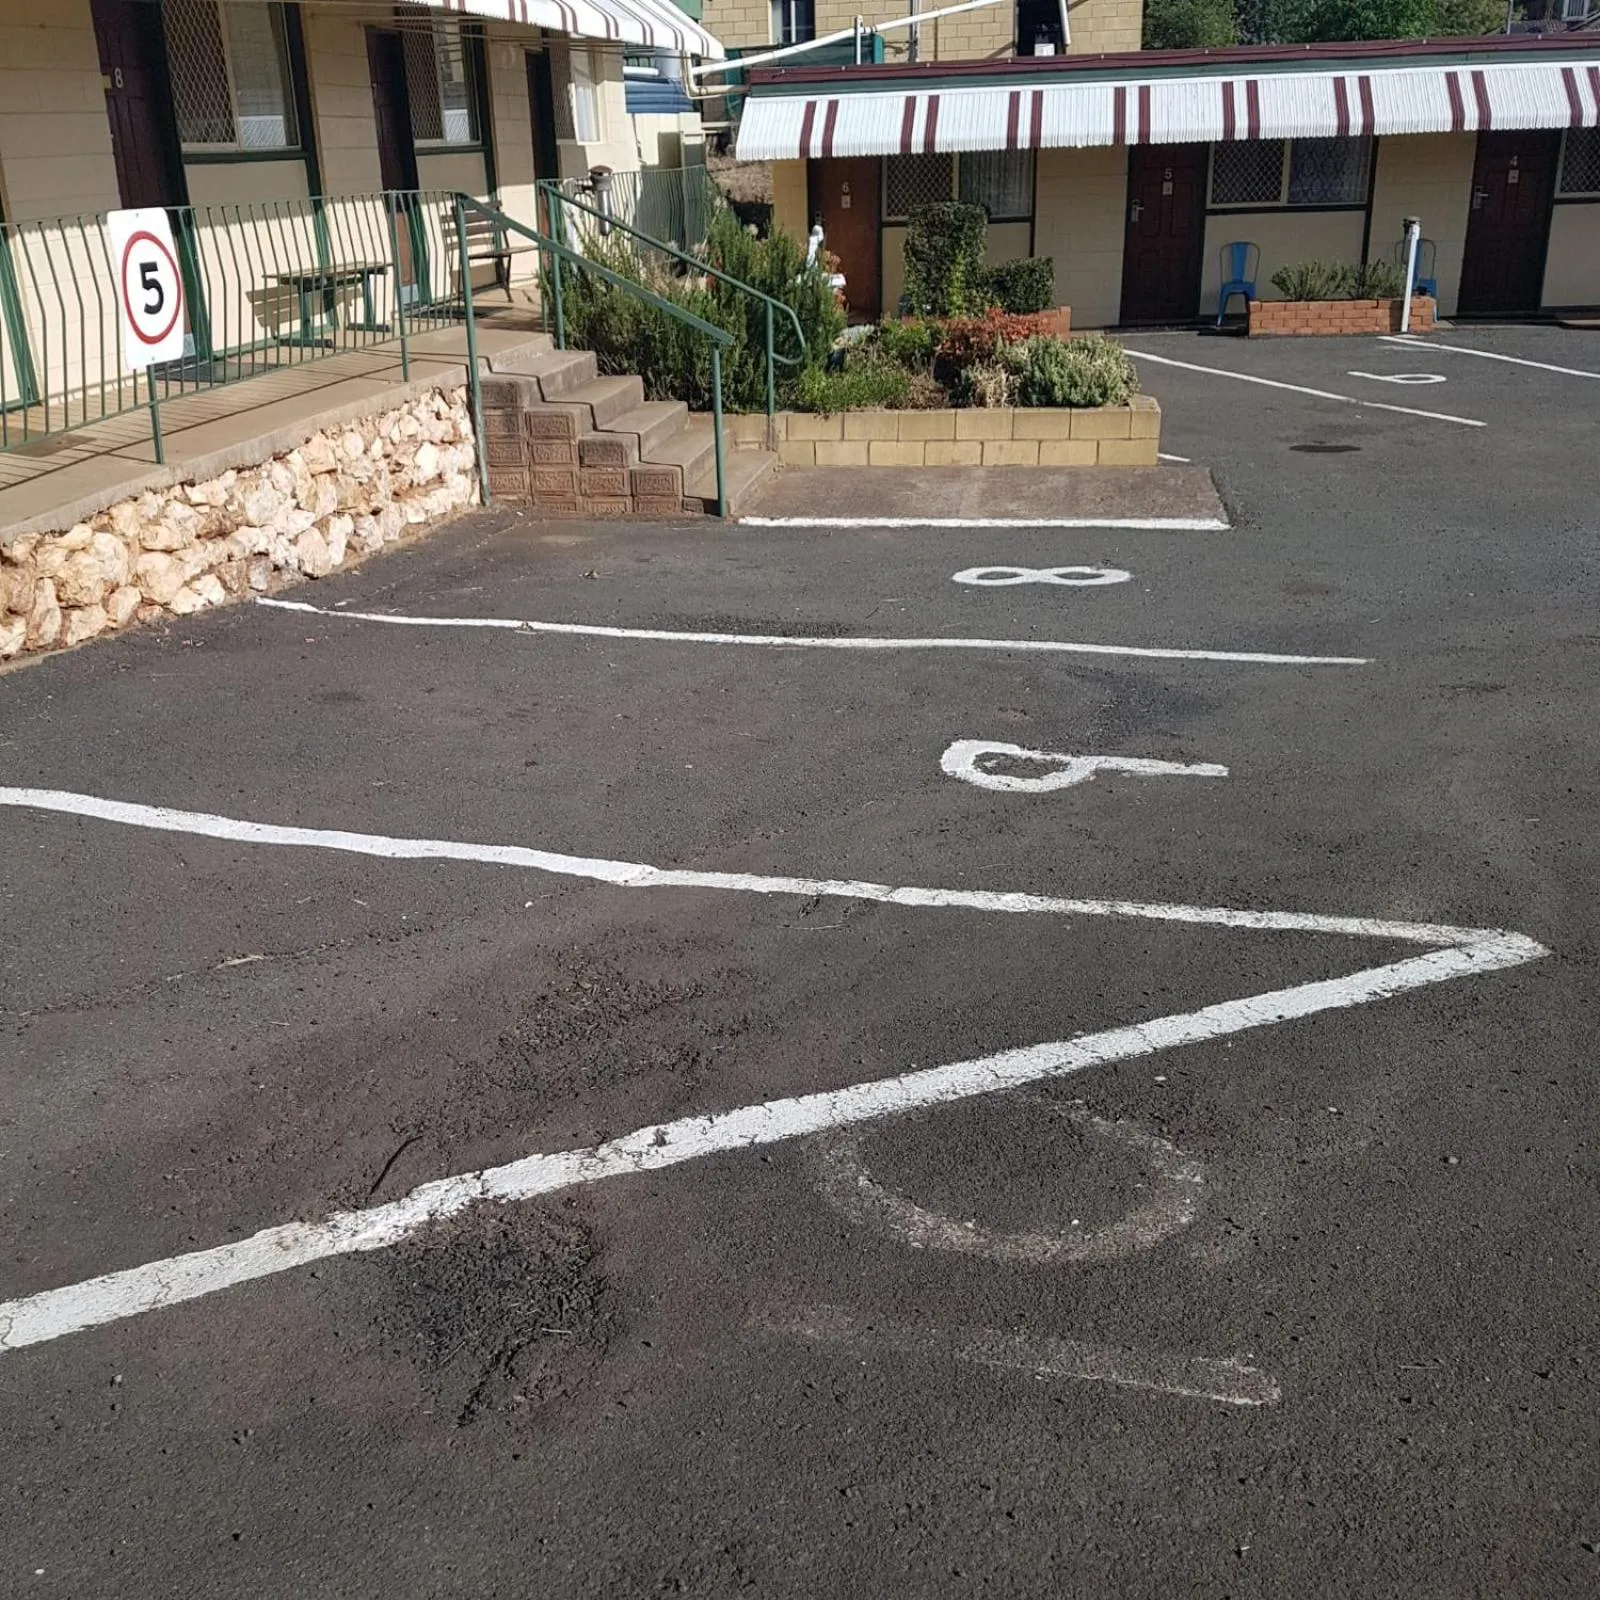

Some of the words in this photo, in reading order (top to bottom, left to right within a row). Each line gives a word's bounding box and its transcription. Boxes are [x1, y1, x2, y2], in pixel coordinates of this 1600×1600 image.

[114, 67, 124, 89] 8
[1509, 154, 1519, 168] 4
[1163, 167, 1173, 180] 5
[841, 181, 850, 193] 6
[139, 261, 165, 315] 5
[952, 565, 1134, 587] 8
[940, 739, 1230, 793] 9
